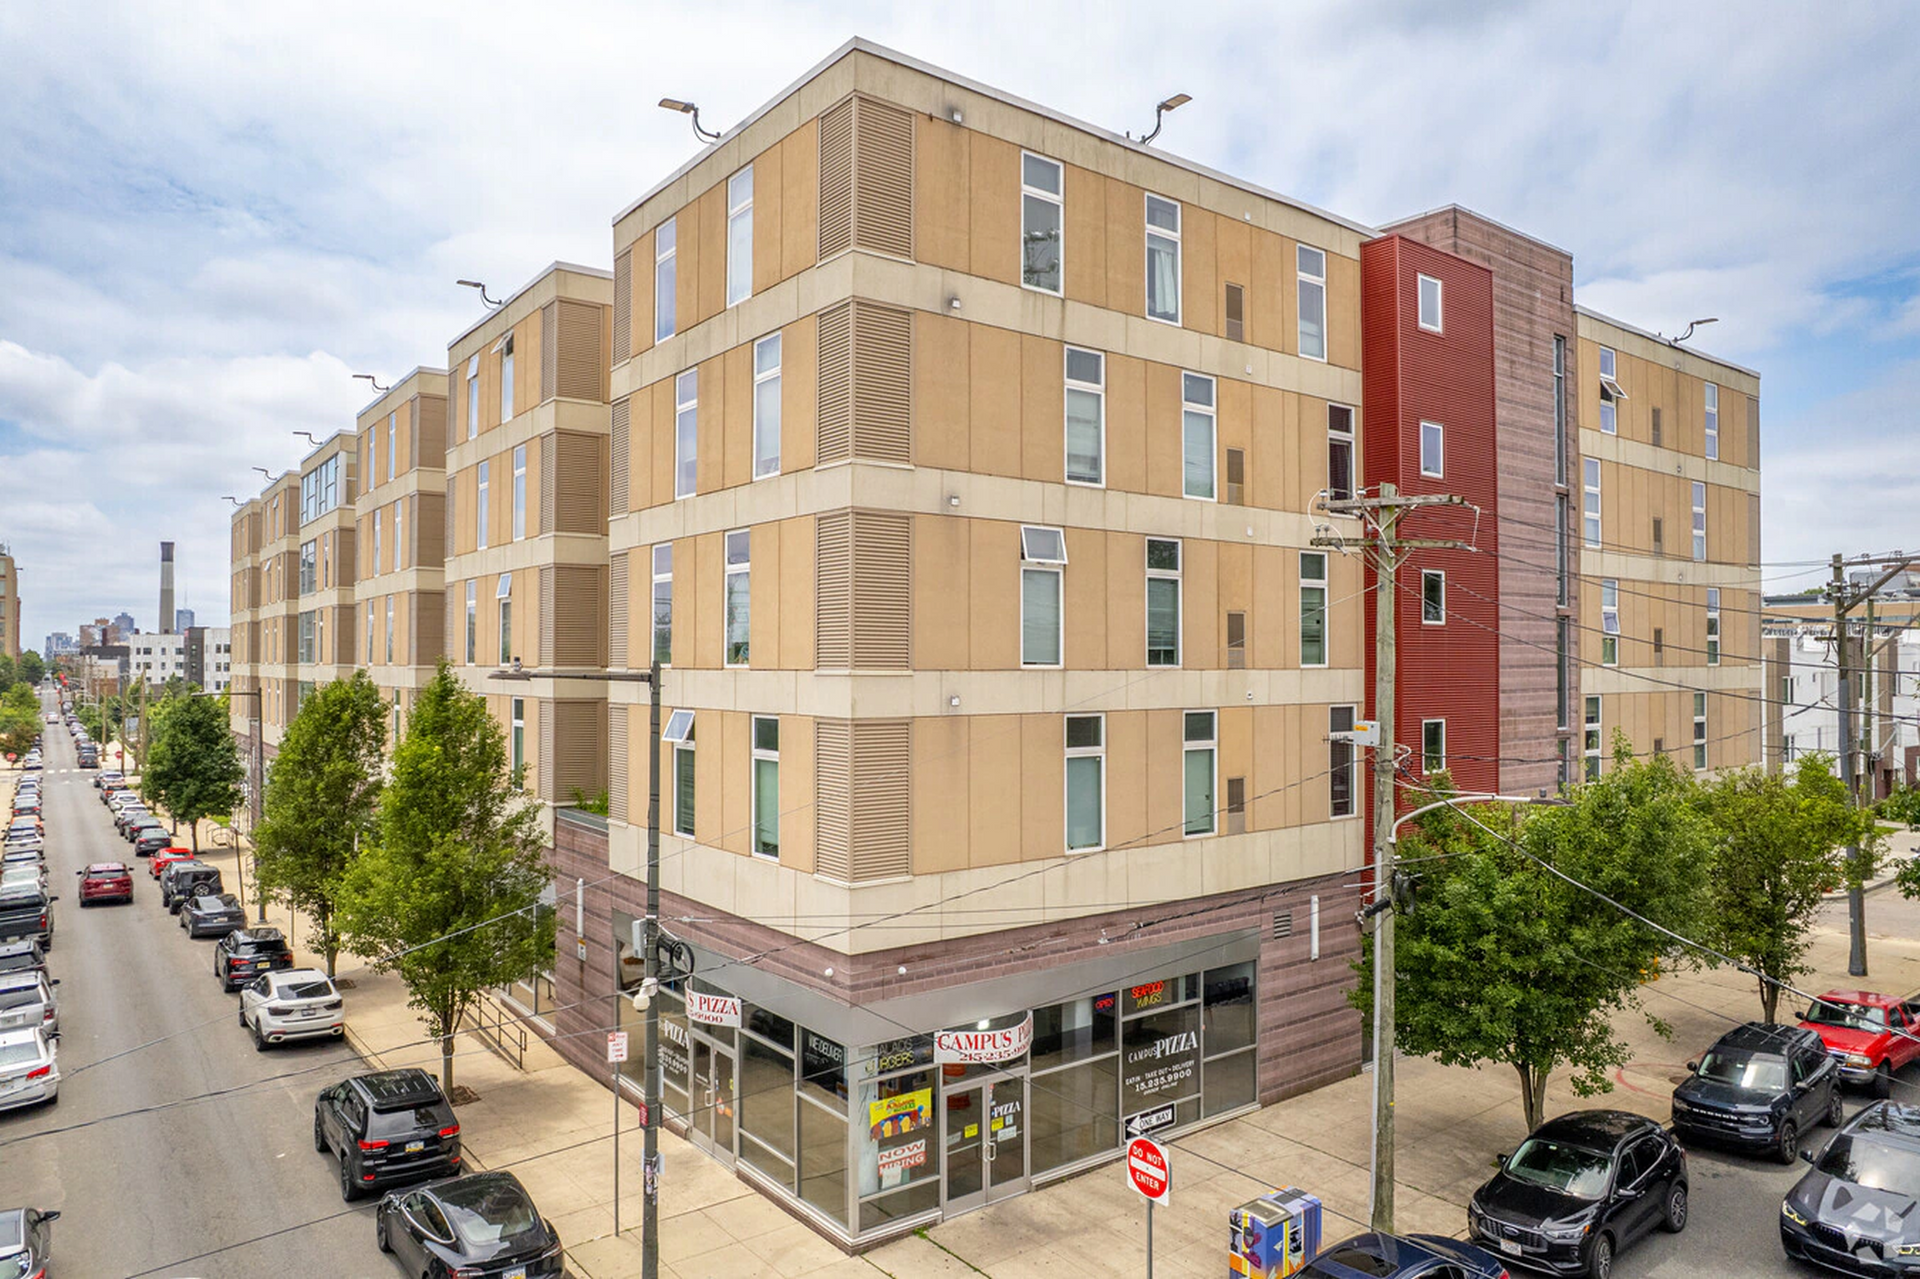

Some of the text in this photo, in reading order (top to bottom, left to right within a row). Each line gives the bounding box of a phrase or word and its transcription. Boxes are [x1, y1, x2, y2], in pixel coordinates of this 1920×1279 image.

[1131, 981, 1164, 998] SEAFOOD
[698, 995, 739, 1016] PIZZA
[1136, 993, 1161, 1008] WINGS
[880, 1038, 914, 1057] ALADS
[937, 1031, 1011, 1050] CAMPUS
[1128, 1031, 1198, 1063] CAMPUS PIZZA
[994, 1101, 1020, 1117] PIZZA
[1139, 1111, 1170, 1129] ONE WAY
[880, 1142, 923, 1161] NOW
[1132, 1145, 1161, 1165] DO NOT
[1136, 1172, 1159, 1190] ENTER
